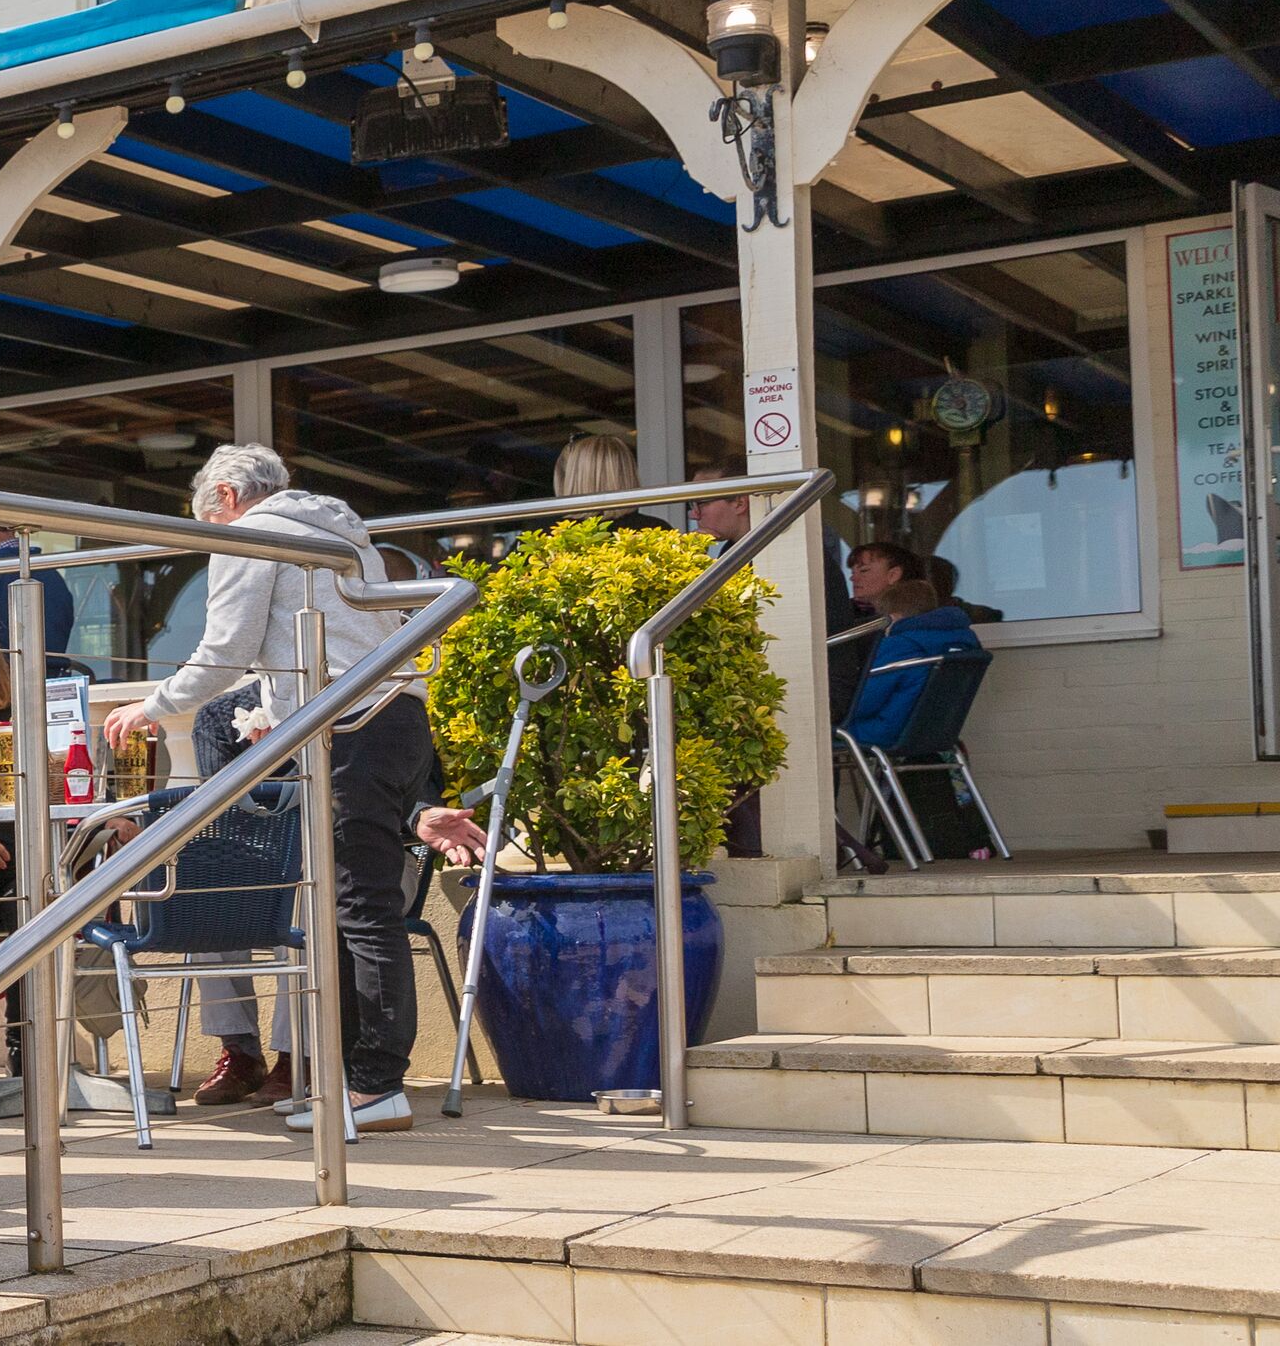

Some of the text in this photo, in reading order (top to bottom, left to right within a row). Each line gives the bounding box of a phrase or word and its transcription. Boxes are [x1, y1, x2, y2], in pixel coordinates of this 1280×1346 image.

[1176, 287, 1235, 304] SPARKL
[1195, 329, 1237, 344] WINE
[1217, 345, 1230, 356] &
[1196, 358, 1238, 373] SPIRI
[763, 375, 778, 383] NO
[748, 383, 793, 395] SMOKING
[1195, 385, 1238, 400] STOU
[759, 394, 784, 404] AREA
[1220, 401, 1232, 412] &
[1198, 414, 1240, 429] CIDE
[1208, 442, 1241, 455] TEA
[1193, 470, 1242, 486] COFFE
